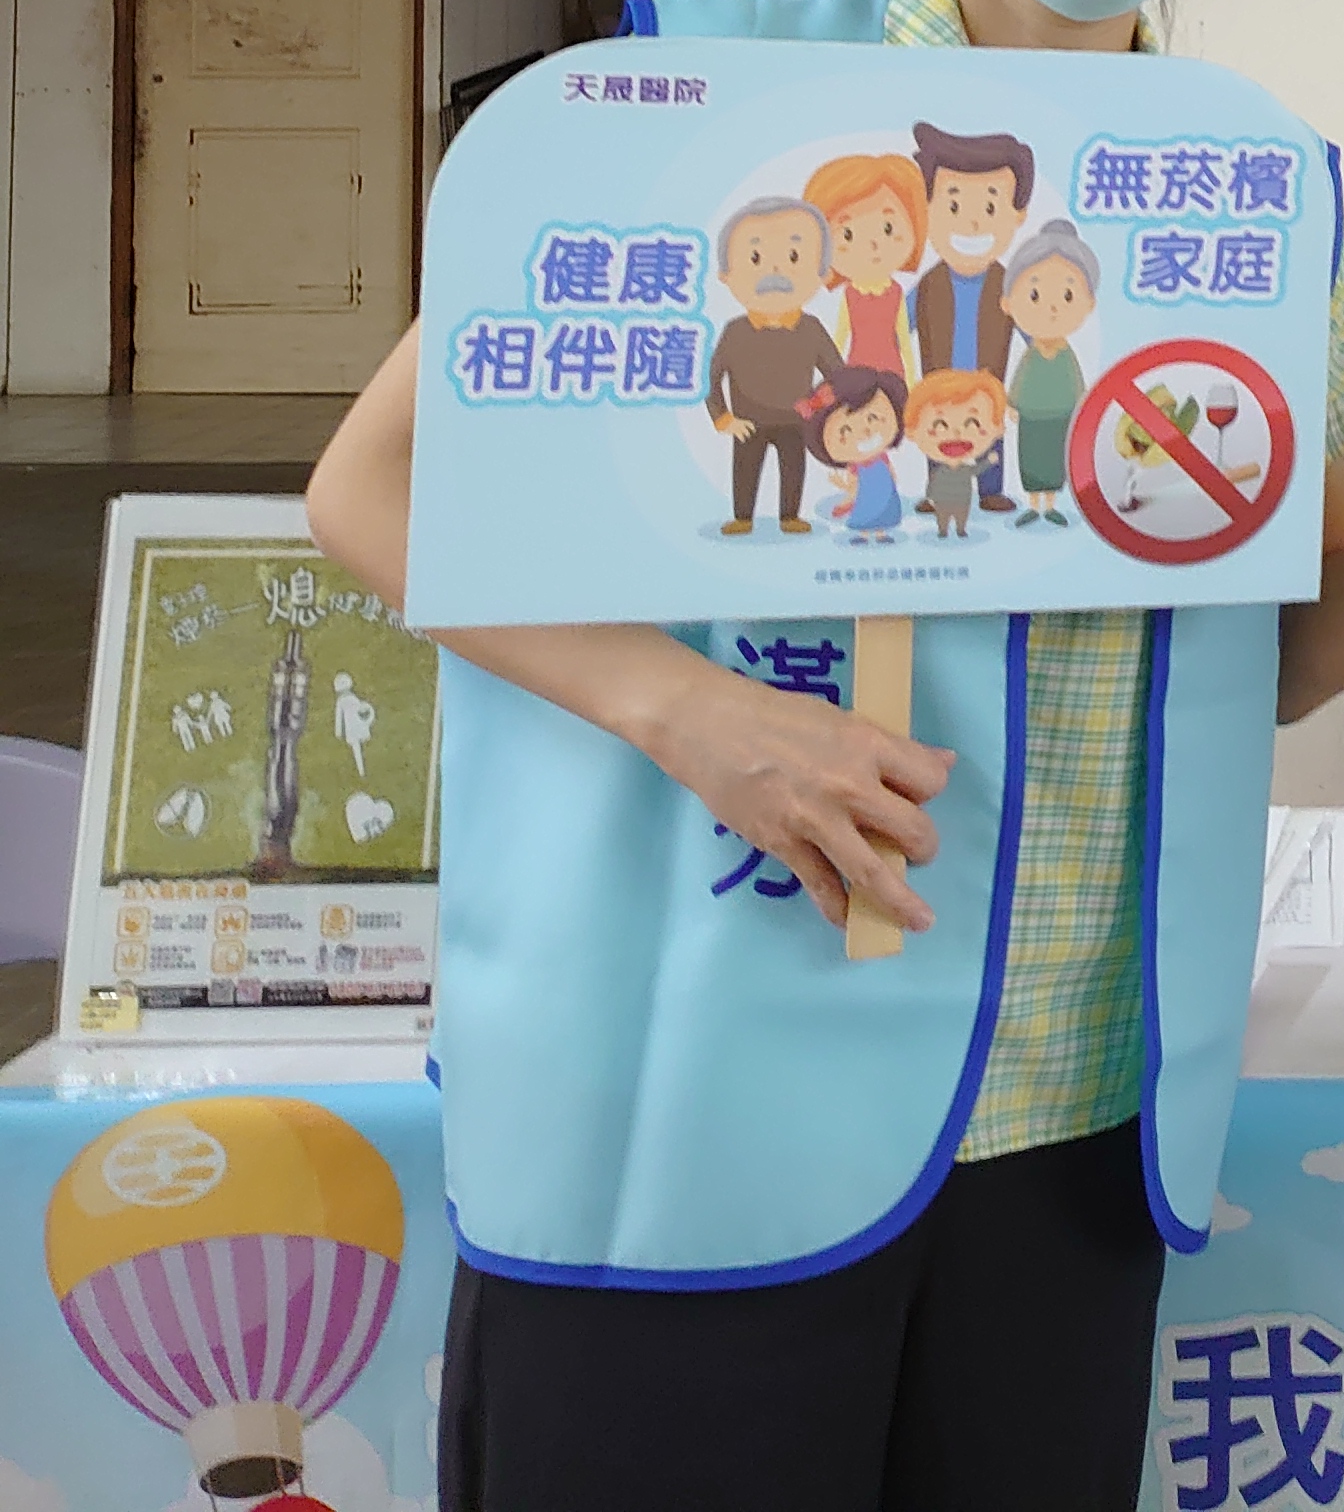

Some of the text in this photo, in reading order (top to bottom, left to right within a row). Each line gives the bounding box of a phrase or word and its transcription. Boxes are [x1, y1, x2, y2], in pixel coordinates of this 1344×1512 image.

[563, 72, 708, 106] 天晟醫院
[1083, 145, 1296, 214] 無菸檳
[540, 236, 697, 306] 健康
[1138, 232, 1277, 294] 家庭
[462, 323, 699, 394] 相伴隨
